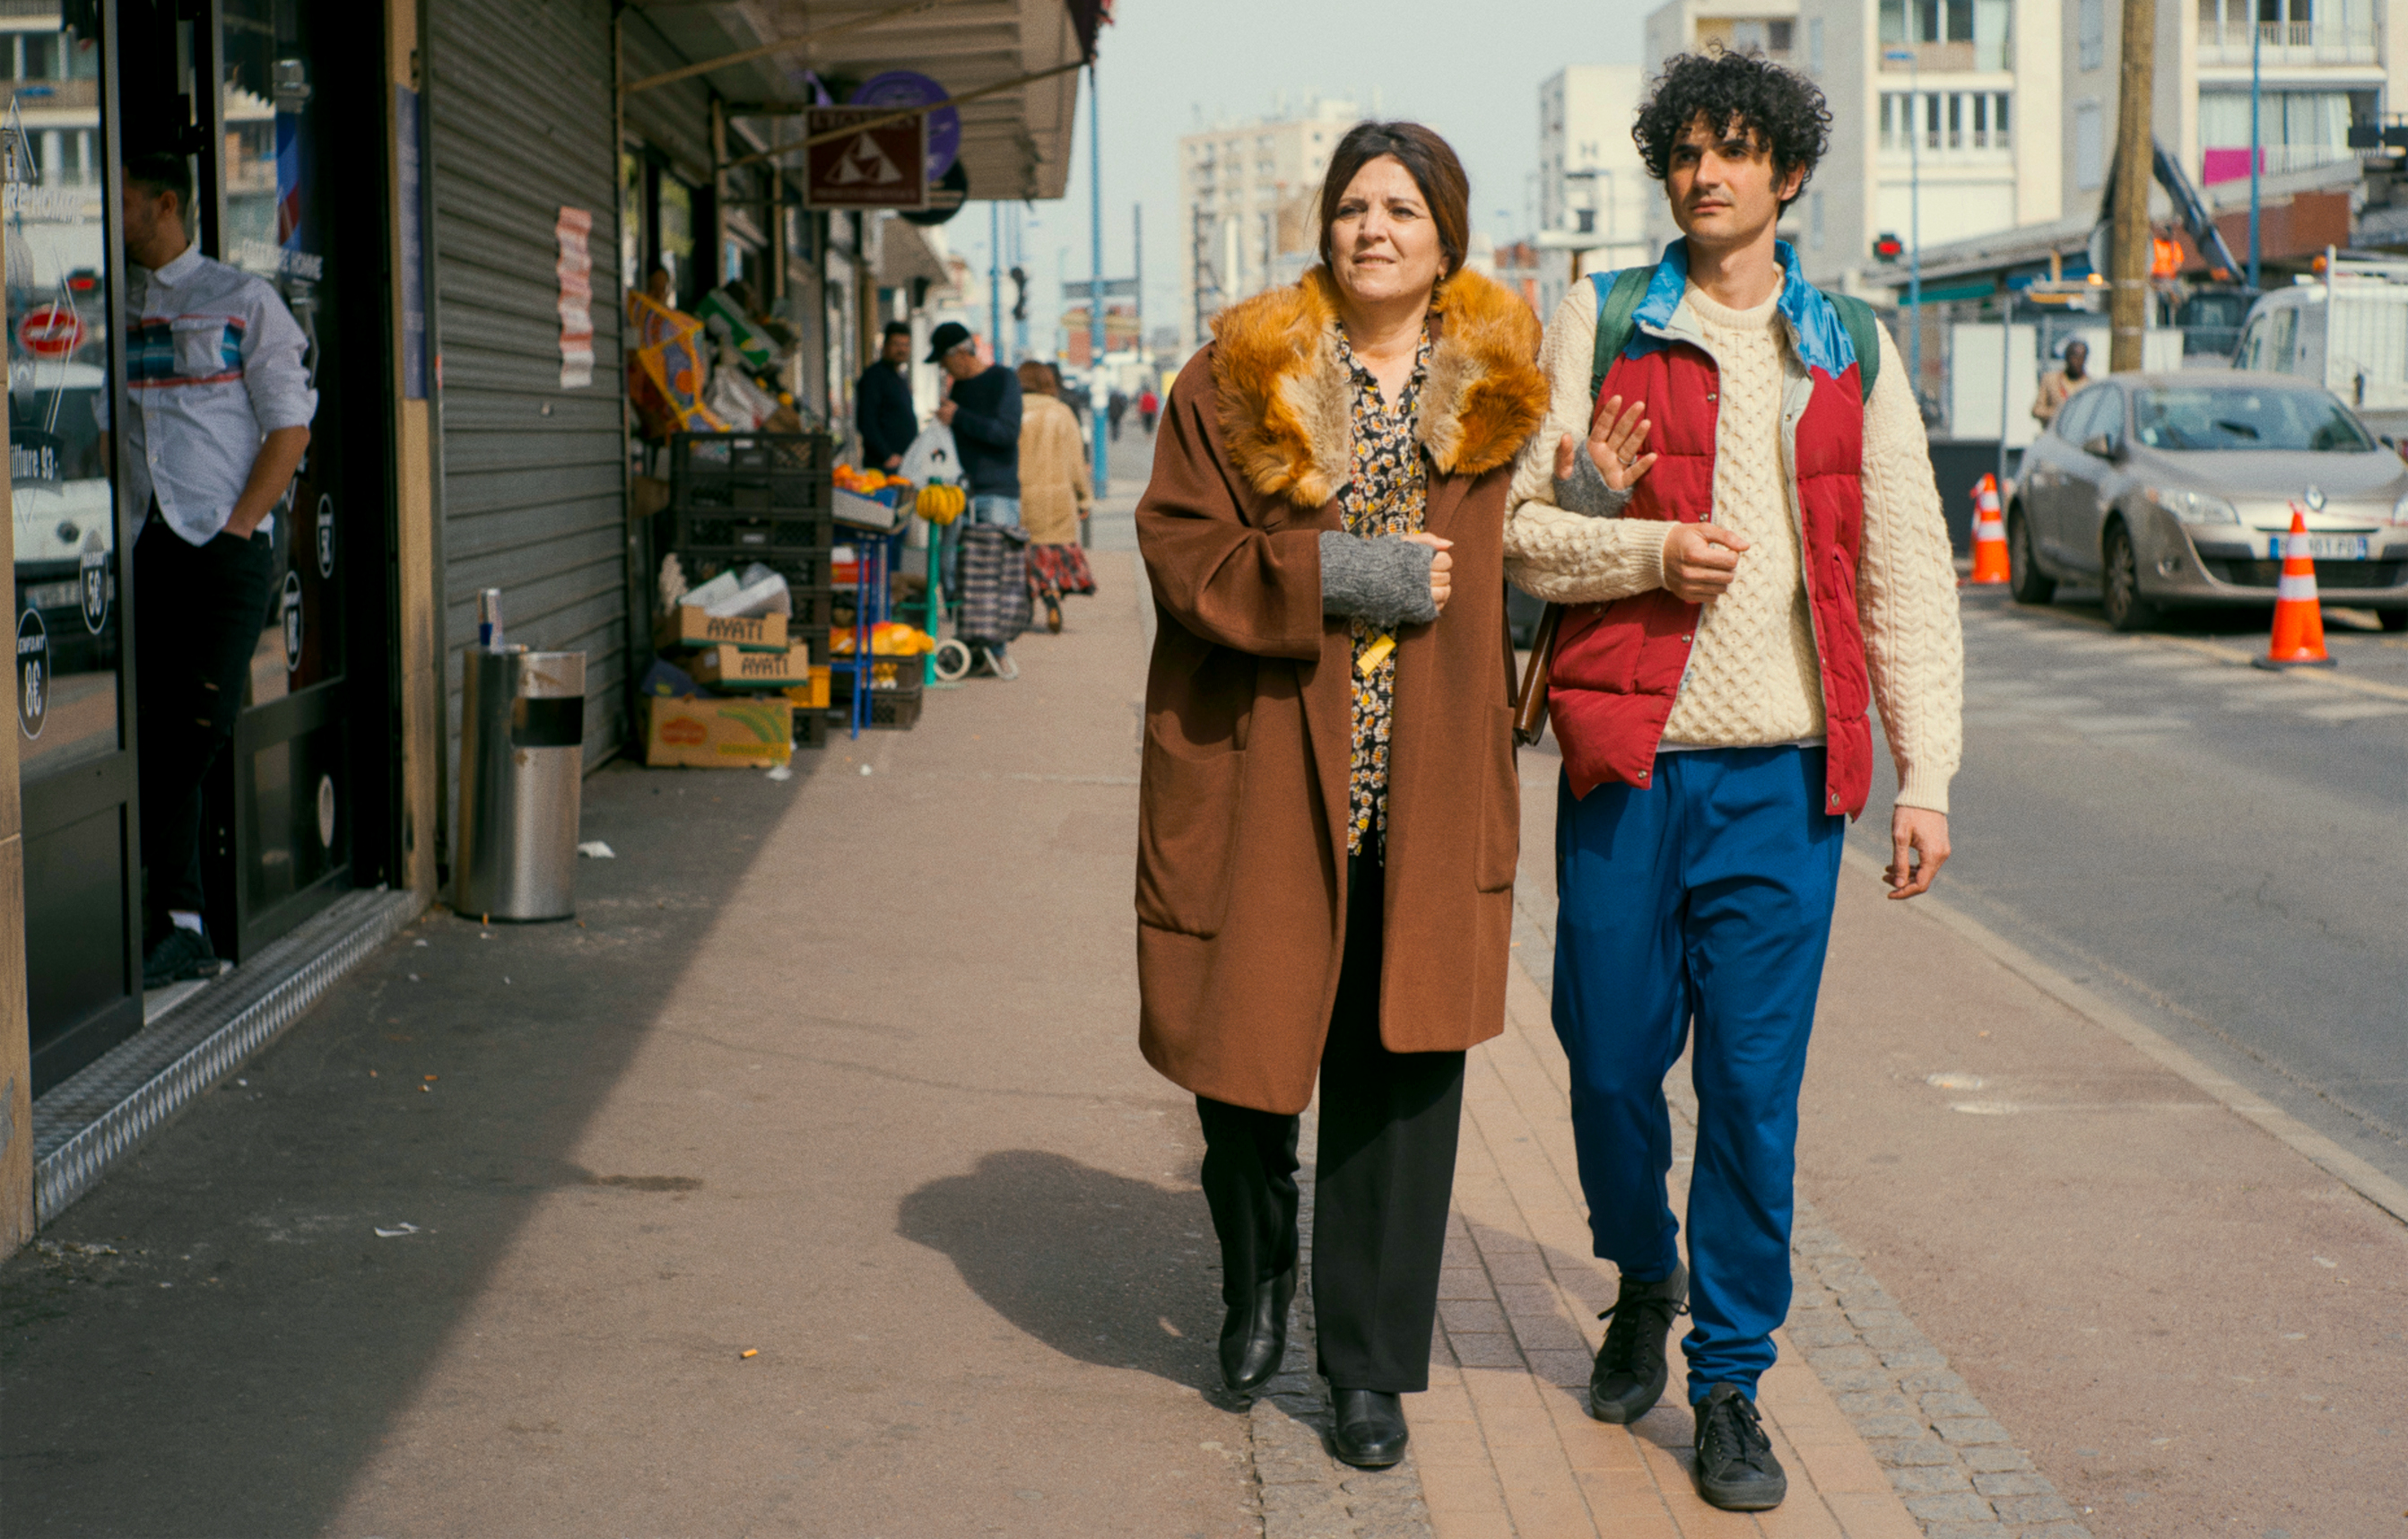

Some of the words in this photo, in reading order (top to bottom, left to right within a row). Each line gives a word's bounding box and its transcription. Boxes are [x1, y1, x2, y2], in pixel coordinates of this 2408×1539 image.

[41, 445, 54, 481] 93
[88, 569, 102, 617] 5€
[706, 618, 763, 640] AYATI
[17, 633, 46, 656] ENFANT
[741, 656, 788, 675] AYATI
[25, 659, 41, 718] 8€
